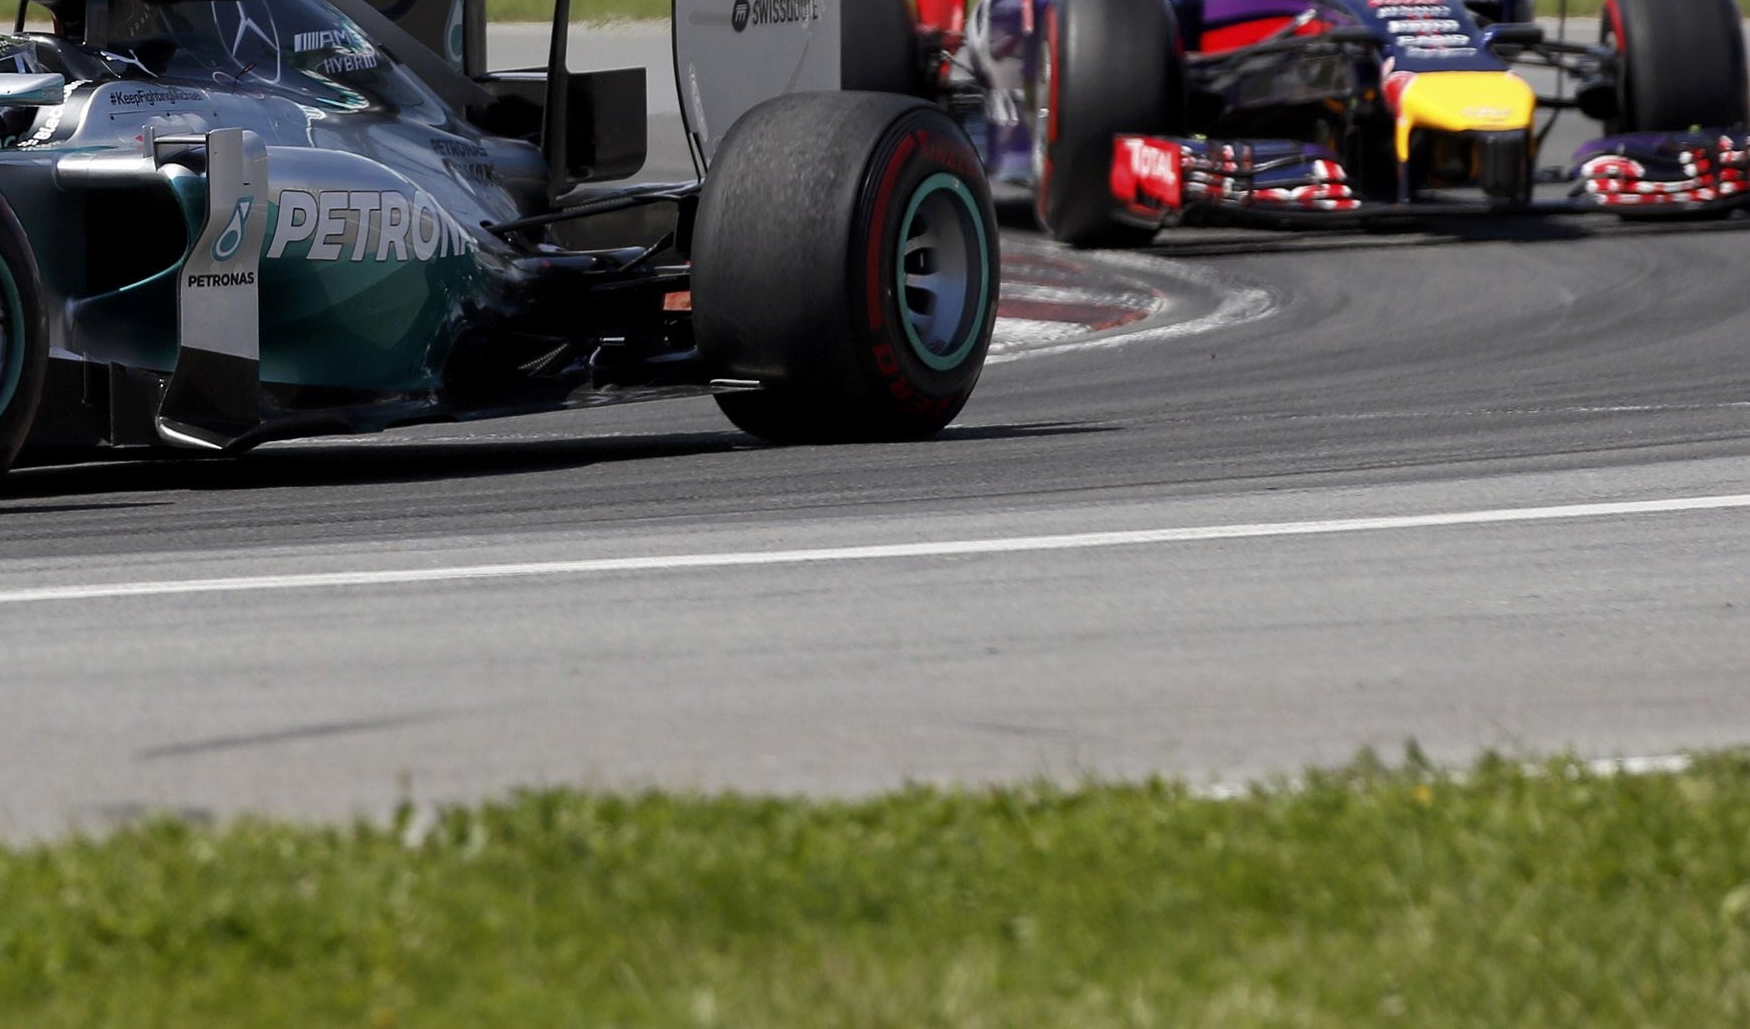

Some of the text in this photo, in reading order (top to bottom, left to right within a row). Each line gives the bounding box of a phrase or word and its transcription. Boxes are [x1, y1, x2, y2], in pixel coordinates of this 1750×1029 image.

[323, 55, 378, 74] HYBRID
[1123, 138, 1178, 186] TOTAL
[187, 271, 255, 288] PETRONAS
